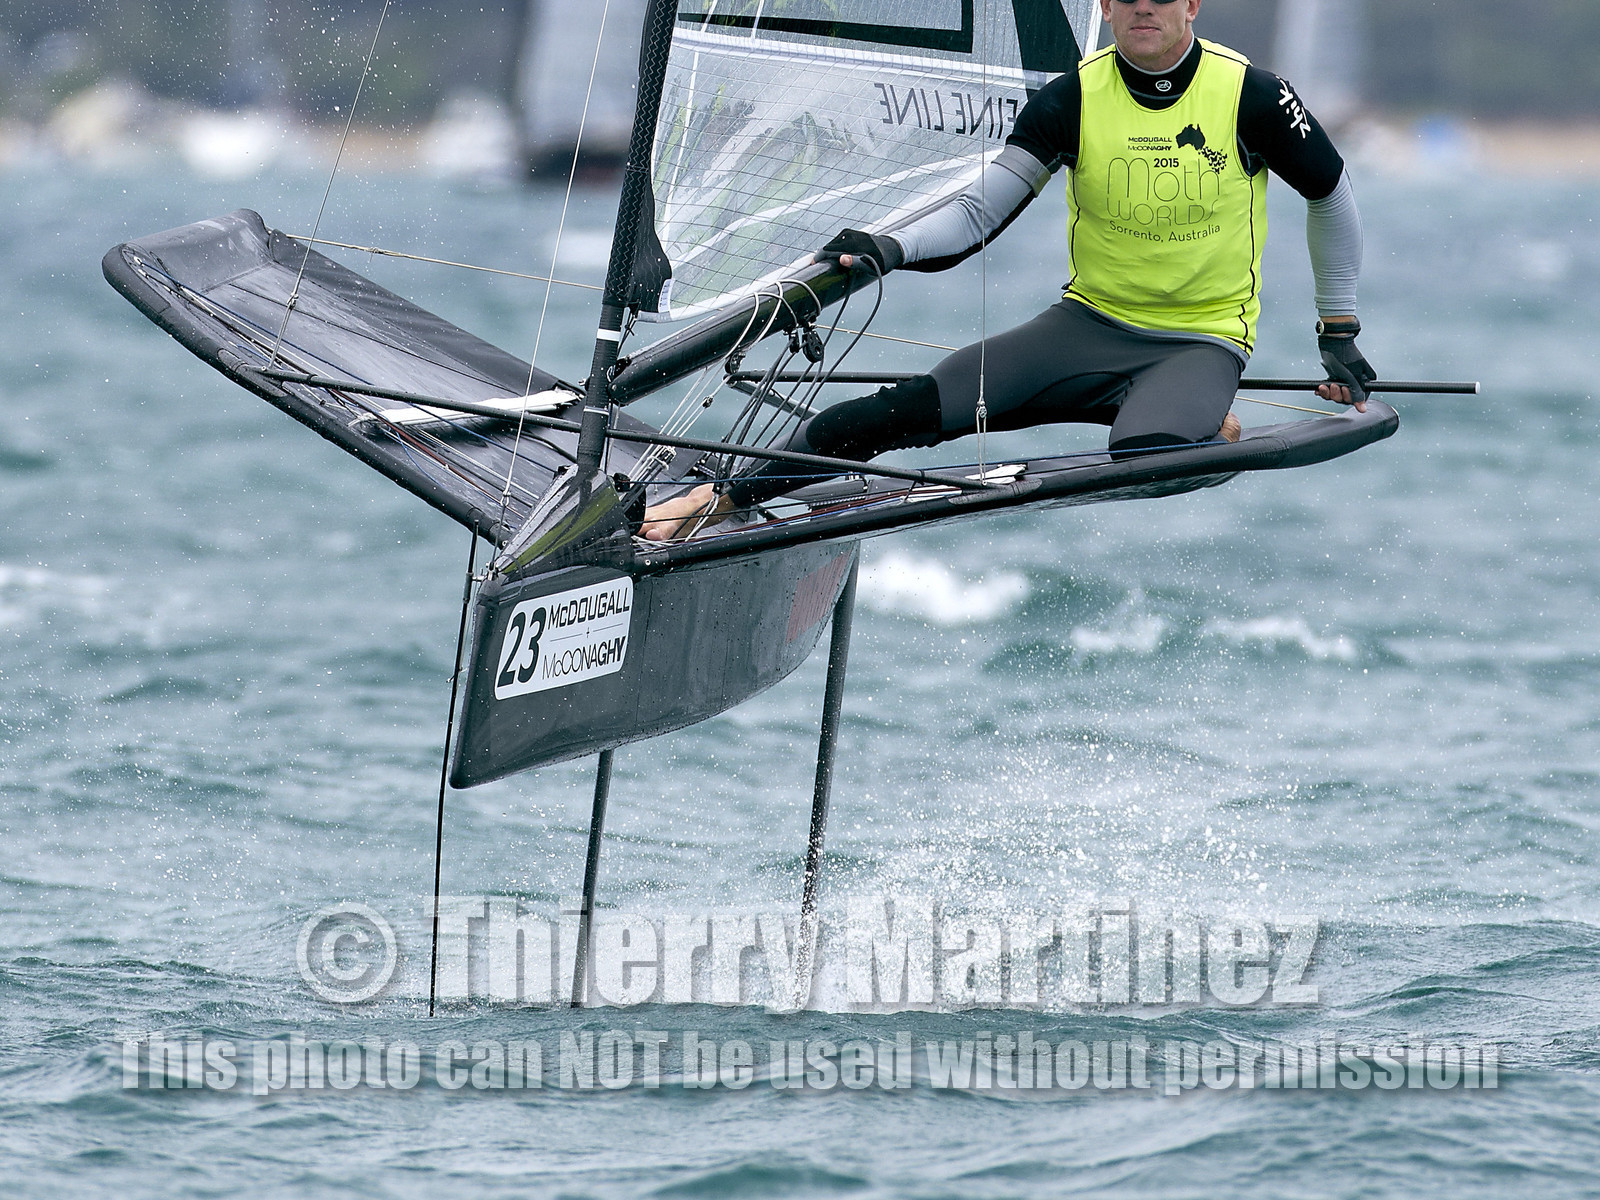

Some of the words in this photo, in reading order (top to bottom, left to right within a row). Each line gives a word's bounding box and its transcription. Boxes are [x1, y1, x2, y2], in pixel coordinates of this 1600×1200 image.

[1154, 158, 1179, 168] 2015
[1109, 220, 1164, 243] Sorrento,
[1168, 224, 1221, 242] Australia
[497, 607, 547, 688] 23
